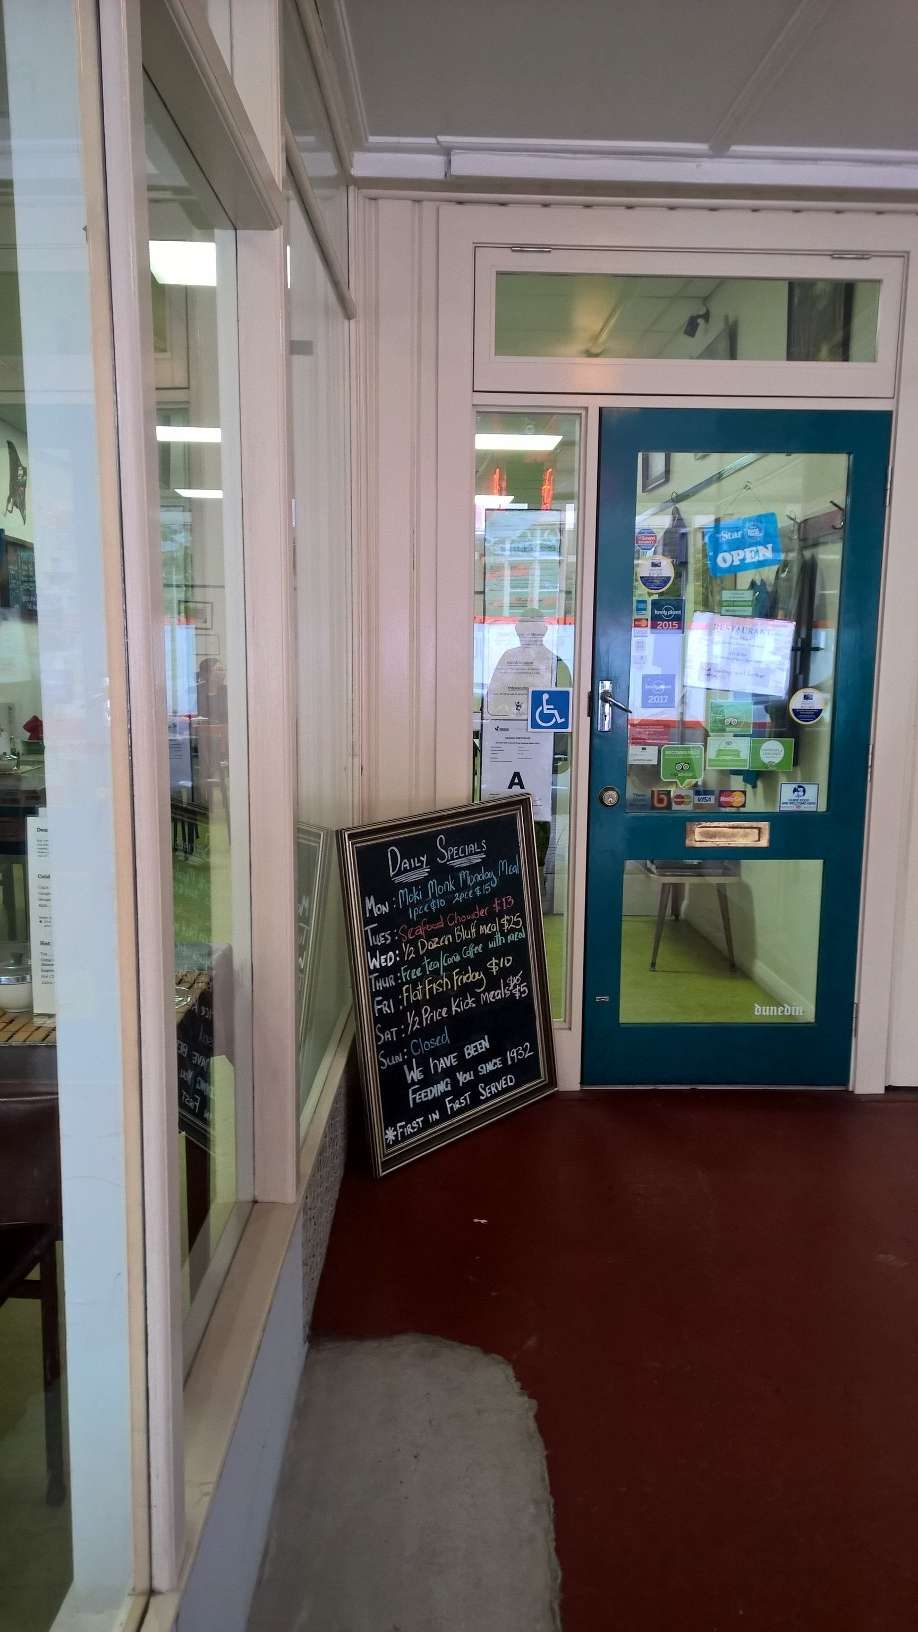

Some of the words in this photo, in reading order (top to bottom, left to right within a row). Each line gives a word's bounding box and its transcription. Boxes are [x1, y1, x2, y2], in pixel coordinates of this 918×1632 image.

[716, 544, 773, 568] OPEN
[657, 621, 679, 629] 2015
[648, 695, 669, 704] 2017
[508, 772, 525, 789] A
[428, 874, 455, 898] Monk
[459, 866, 497, 888] Monday
[498, 854, 519, 877] Meal
[447, 904, 489, 926] Chowder
[455, 920, 477, 942] Bluff
[501, 913, 523, 932] $25
[401, 965, 422, 982] Free
[488, 931, 505, 948] with
[403, 981, 422, 1006] Flat
[453, 966, 486, 992] Friday
[487, 957, 512, 975] $10
[422, 1005, 448, 1027] Price
[410, 1026, 449, 1056] Closed
[464, 1035, 490, 1059] BEEN
[408, 1078, 451, 1108] FEEDING
[478, 1057, 503, 1075] SINCE
[507, 1042, 534, 1065] 1932
[478, 1075, 515, 1099] SERVED
